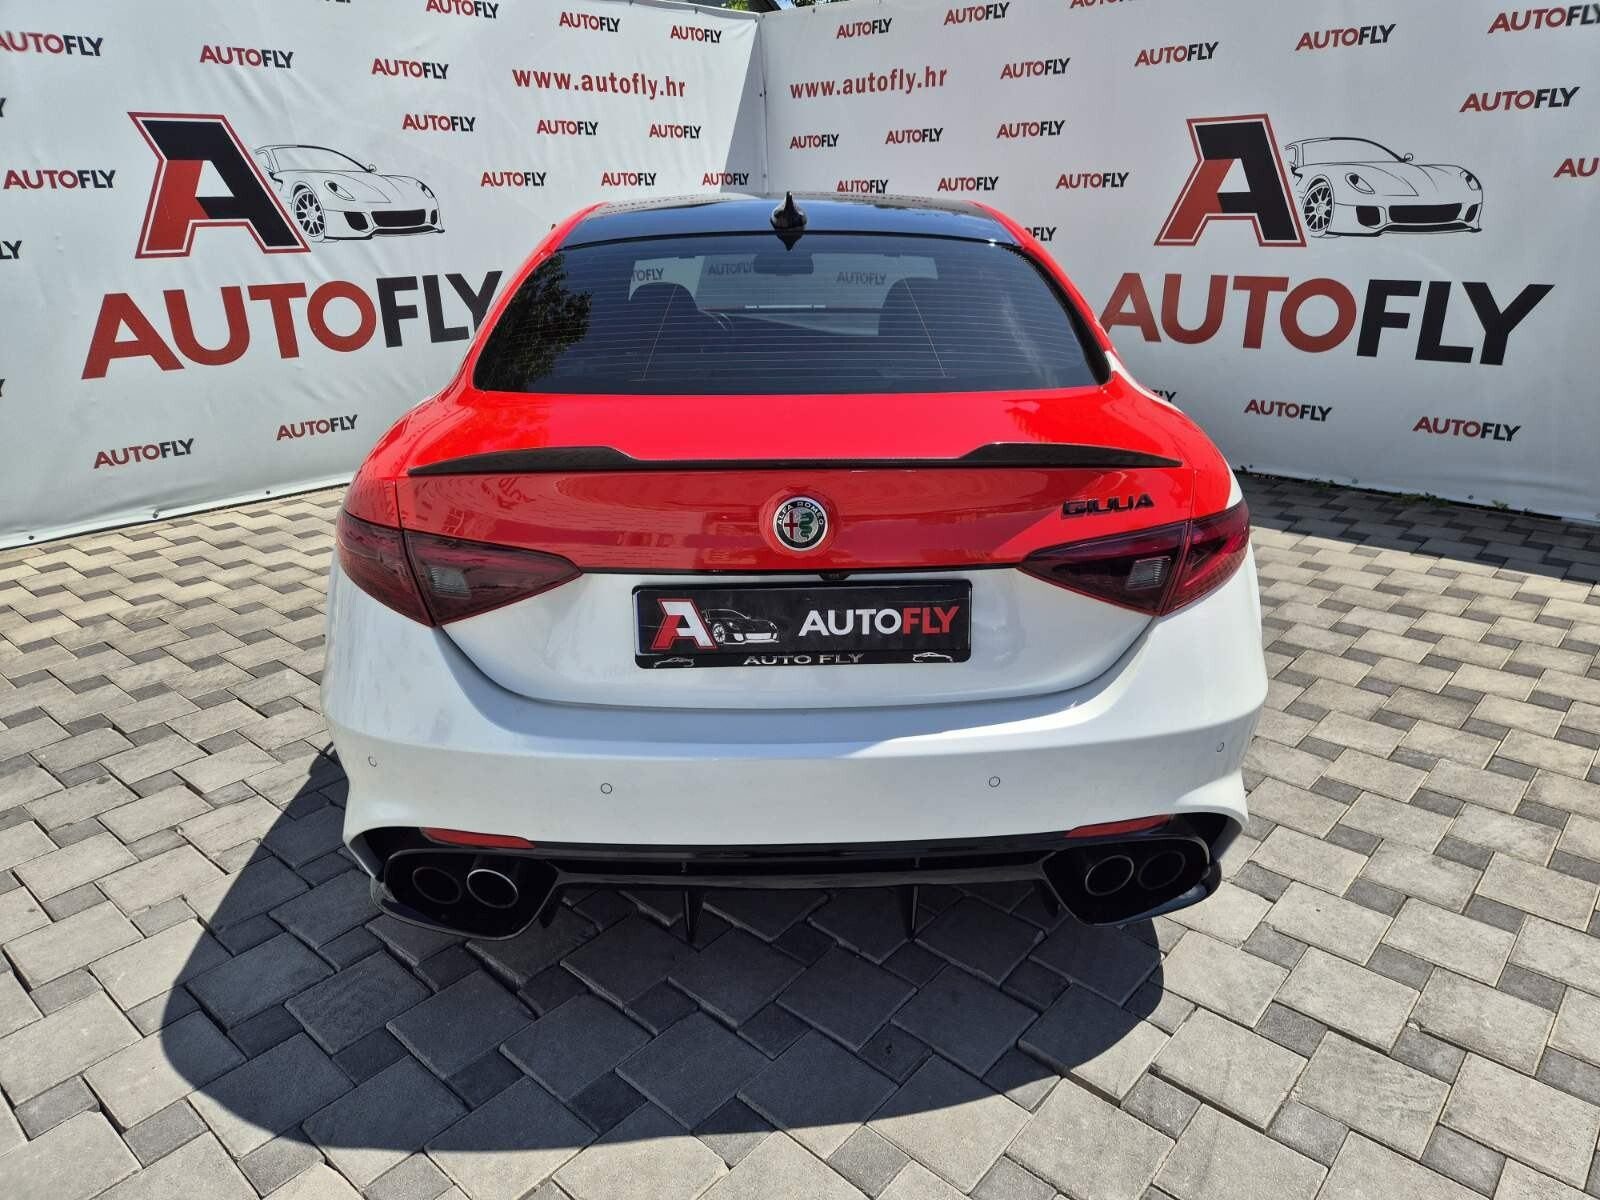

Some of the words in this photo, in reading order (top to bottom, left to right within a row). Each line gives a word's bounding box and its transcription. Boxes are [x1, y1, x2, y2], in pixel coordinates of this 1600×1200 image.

[426, 0, 499, 19] AUTOFLY
[944, 2, 1010, 26] AUTOFLY
[559, 12, 620, 32] AUTOFLY
[836, 17, 892, 39] AUTOFLY
[670, 25, 722, 44] AUTOFLY
[1295, 24, 1396, 51] AUTOFLY
[200, 45, 294, 69] AUTOFLY
[1134, 41, 1219, 67] AUTOFLY
[371, 58, 449, 80] AUTOFLY
[1000, 57, 1071, 79] AUTOFLY
[512, 69, 685, 100] www.autofly.hr
[790, 66, 947, 99] www.autofly.hr
[1459, 86, 1581, 112] AUTOFLY
[402, 114, 476, 132] AUTOFLY
[537, 120, 599, 136] AUTOFLY
[649, 124, 701, 139] AUTOFLY
[996, 120, 1066, 139] AUTOFLY
[789, 134, 839, 149] AUTOFLY
[885, 128, 943, 144] AUTOFLY
[3, 169, 116, 189] AUTOFLY
[127, 112, 311, 259] A
[481, 171, 547, 187] AUTOFLY
[601, 172, 657, 186] AUTOFLY
[702, 172, 750, 186] AUTOFLY
[837, 179, 888, 193] AUTOFLY
[937, 176, 999, 192] AUTOFLY
[1056, 172, 1129, 189] AUTOFLY
[1155, 113, 1307, 247] A
[836, 271, 887, 285] AUTOFLY
[81, 270, 503, 379] AUTOFLY
[1099, 272, 1555, 366] AUTOFLY
[1244, 399, 1332, 422] AUTOFLY
[276, 414, 358, 441] AUTOFLY
[1413, 416, 1521, 442] AUTOFLY
[94, 438, 194, 469] AUTOFLY
[777, 504, 795, 525] ALFA
[797, 501, 825, 525] ROMEO
[1063, 494, 1154, 515] GIULIA
[798, 606, 960, 637] AUTOFLY
[743, 655, 812, 666] AUTO
[819, 652, 865, 665] FLY
